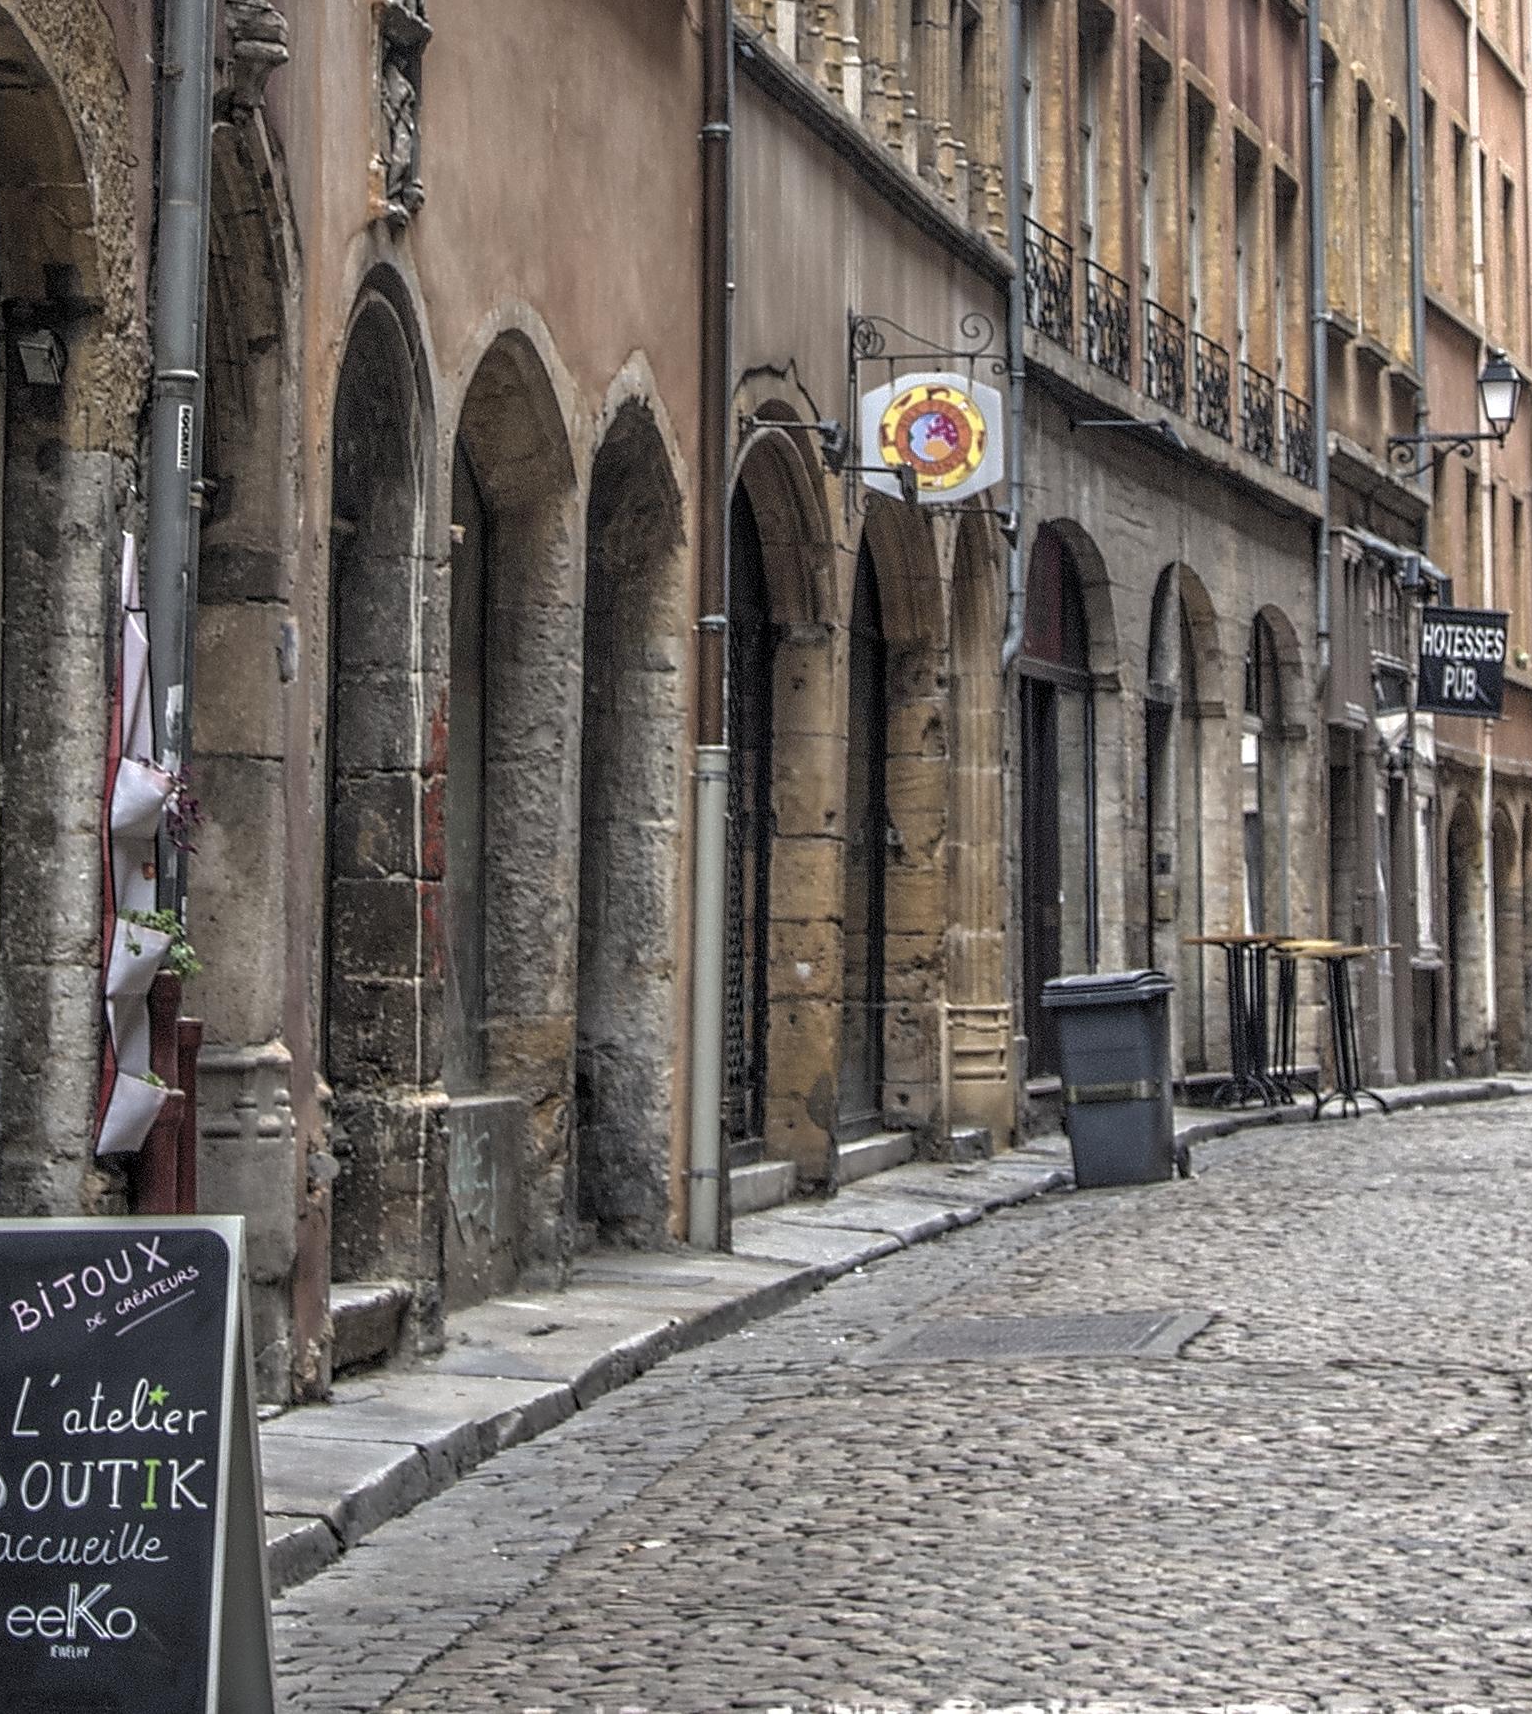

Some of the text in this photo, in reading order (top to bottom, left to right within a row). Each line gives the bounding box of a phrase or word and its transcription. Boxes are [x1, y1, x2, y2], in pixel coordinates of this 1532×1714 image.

[1421, 623, 1506, 664] HOTESSES
[1442, 665, 1478, 702] PUB
[85, 1264, 201, 1333] DE CRÉATEURS
[12, 1373, 208, 1439] L'atelier
[5, 1582, 139, 1641] eeKo
